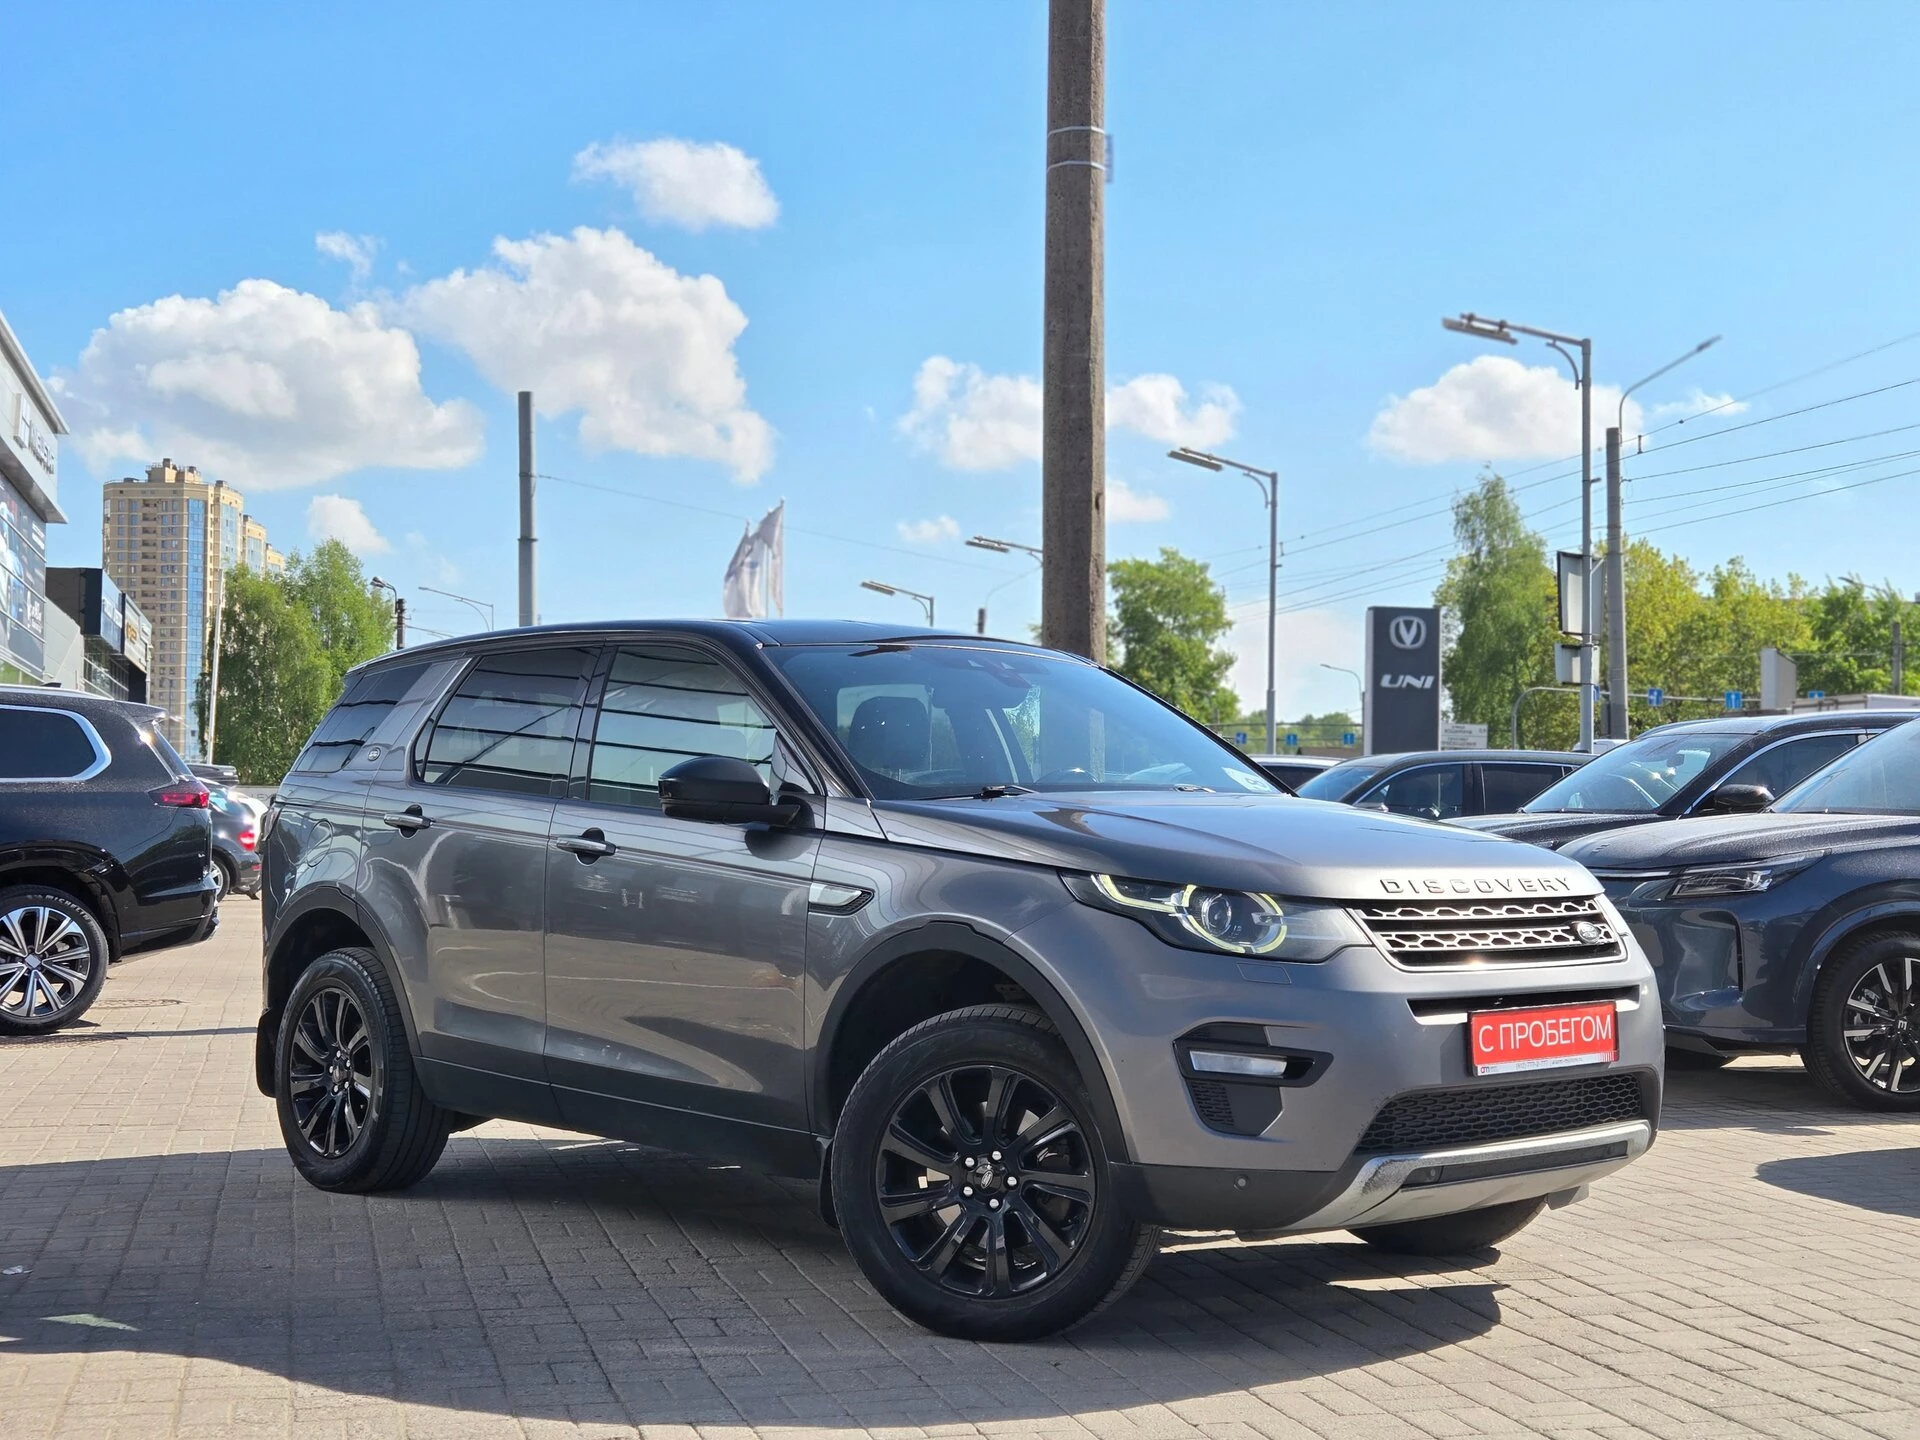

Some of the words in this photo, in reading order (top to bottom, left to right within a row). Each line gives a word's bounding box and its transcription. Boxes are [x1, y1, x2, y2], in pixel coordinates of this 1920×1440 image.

[1380, 674, 1435, 689] UNI
[1380, 878, 1571, 894] DISCOVERY
[45, 894, 91, 921] MICHELIN
[1479, 1024, 1494, 1052] С
[1499, 1014, 1612, 1050] ПРОБЕГОМ
